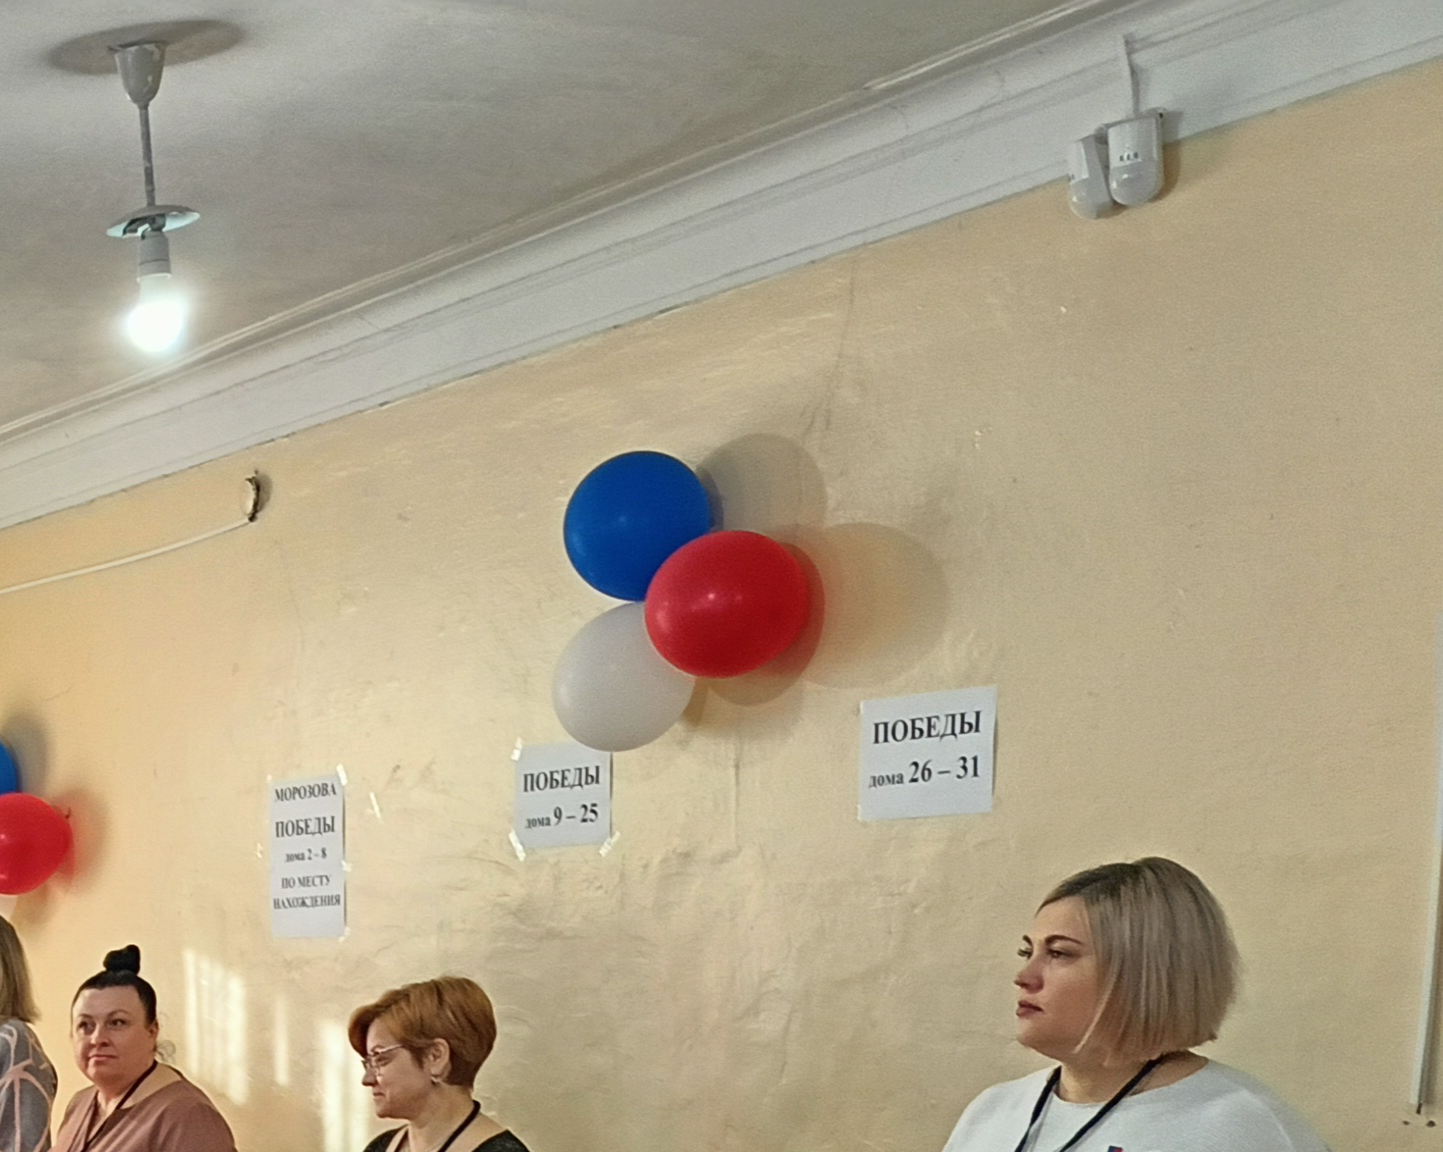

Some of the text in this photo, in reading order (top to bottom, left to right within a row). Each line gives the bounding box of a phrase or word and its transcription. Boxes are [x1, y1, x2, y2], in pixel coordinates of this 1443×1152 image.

[873, 710, 982, 744] ПОБЕДЫ
[523, 765, 600, 792] ПОБЕДЫ
[868, 772, 904, 789] дома
[908, 759, 933, 784] 26
[956, 755, 980, 780] 31
[274, 782, 337, 802] МОРОЗОВА
[275, 815, 335, 838] ПОБЕДЫ
[525, 816, 551, 829] дома
[553, 806, 563, 826] 9
[580, 803, 599, 824] 25
[284, 851, 305, 863] дома
[306, 848, 313, 861] 2
[320, 847, 327, 860] 8
[281, 874, 331, 889] ПО МЕСТУ
[273, 894, 341, 909] НАХОЖДЕНИЯ
